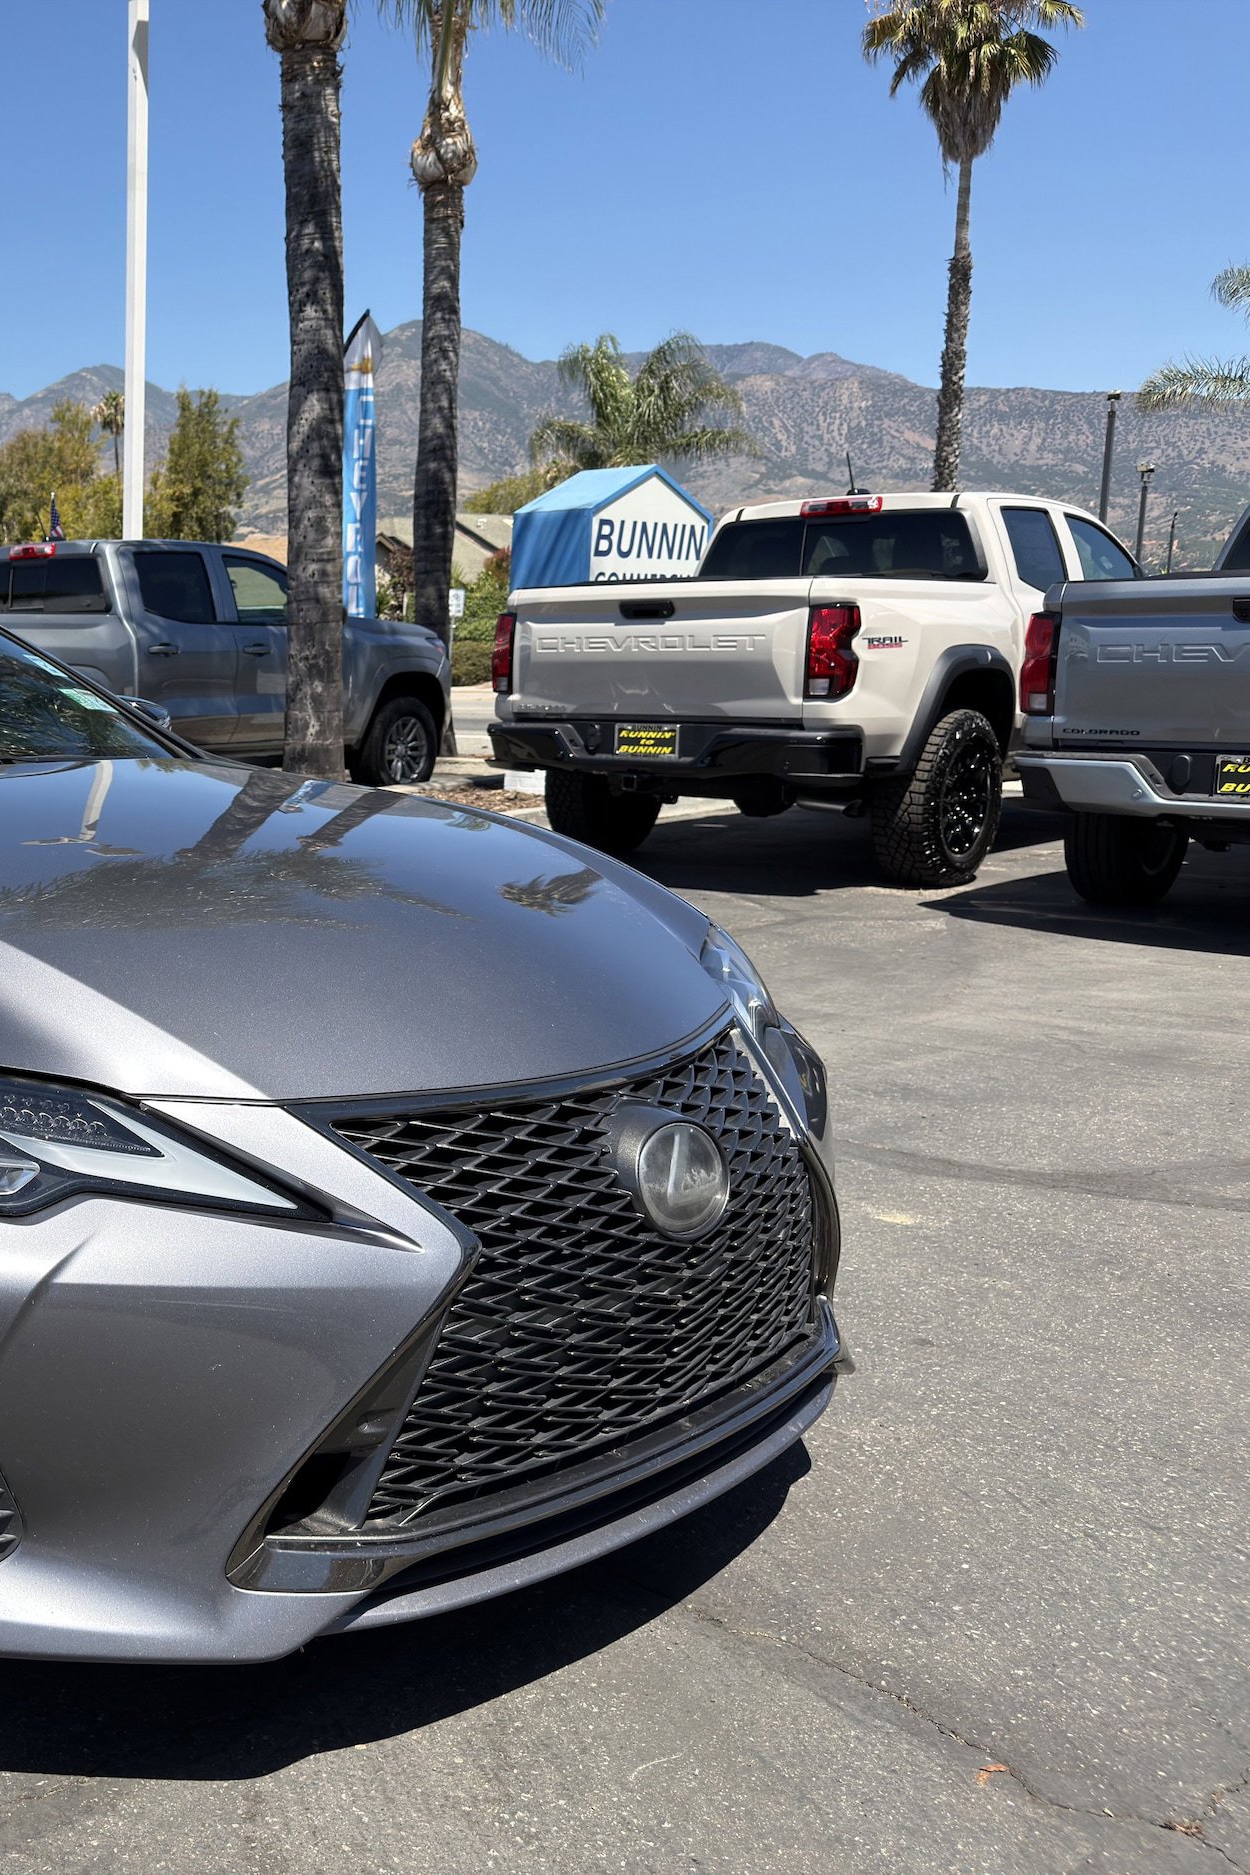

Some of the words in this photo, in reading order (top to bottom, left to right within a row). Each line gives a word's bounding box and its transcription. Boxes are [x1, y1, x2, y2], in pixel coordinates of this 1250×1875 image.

[593, 518, 705, 561] BUNNIN
[536, 634, 766, 653] CHEVROLET
[862, 636, 908, 644] TRAIL
[1062, 728, 1141, 736] COLORADO
[619, 745, 673, 754] BUNNIN
